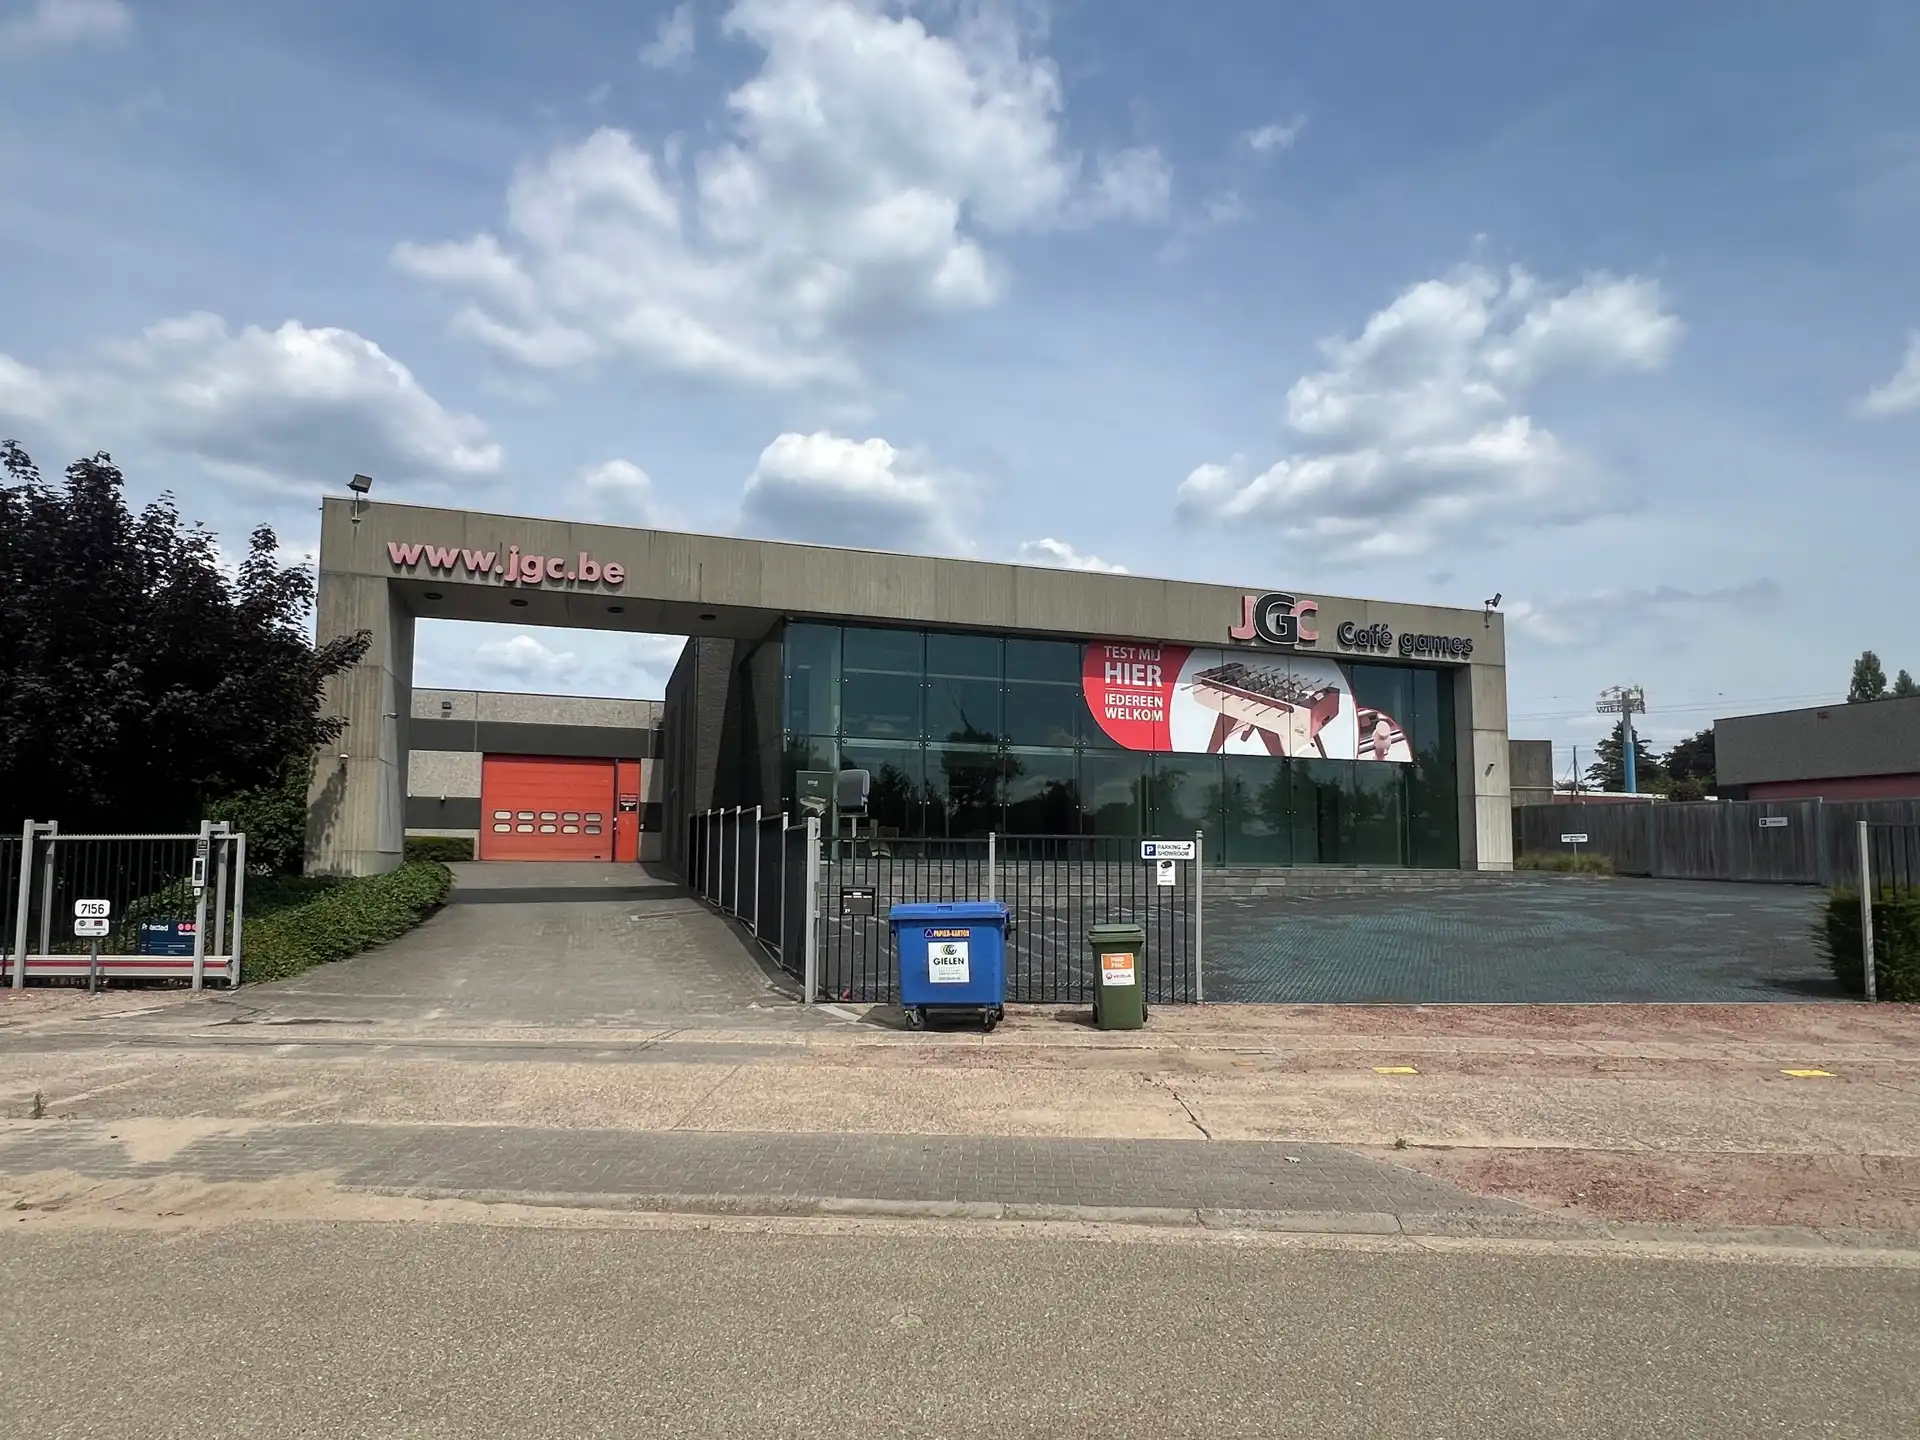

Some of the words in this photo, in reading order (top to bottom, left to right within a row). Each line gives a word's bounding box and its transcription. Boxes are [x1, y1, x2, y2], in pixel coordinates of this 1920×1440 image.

[387, 542, 624, 583] www.jgc.be
[1230, 592, 1319, 644] JGC
[1338, 621, 1393, 646] Café
[1400, 632, 1473, 656] games
[1104, 645, 1135, 659] TEST
[1139, 649, 1161, 661] MIJ
[1104, 662, 1162, 687] HIER
[1105, 693, 1163, 707] IEDEREEN
[1105, 707, 1163, 721] WELKOM
[80, 903, 105, 915] 7156
[141, 922, 168, 932] Prtected
[933, 957, 964, 965] GIELEN
